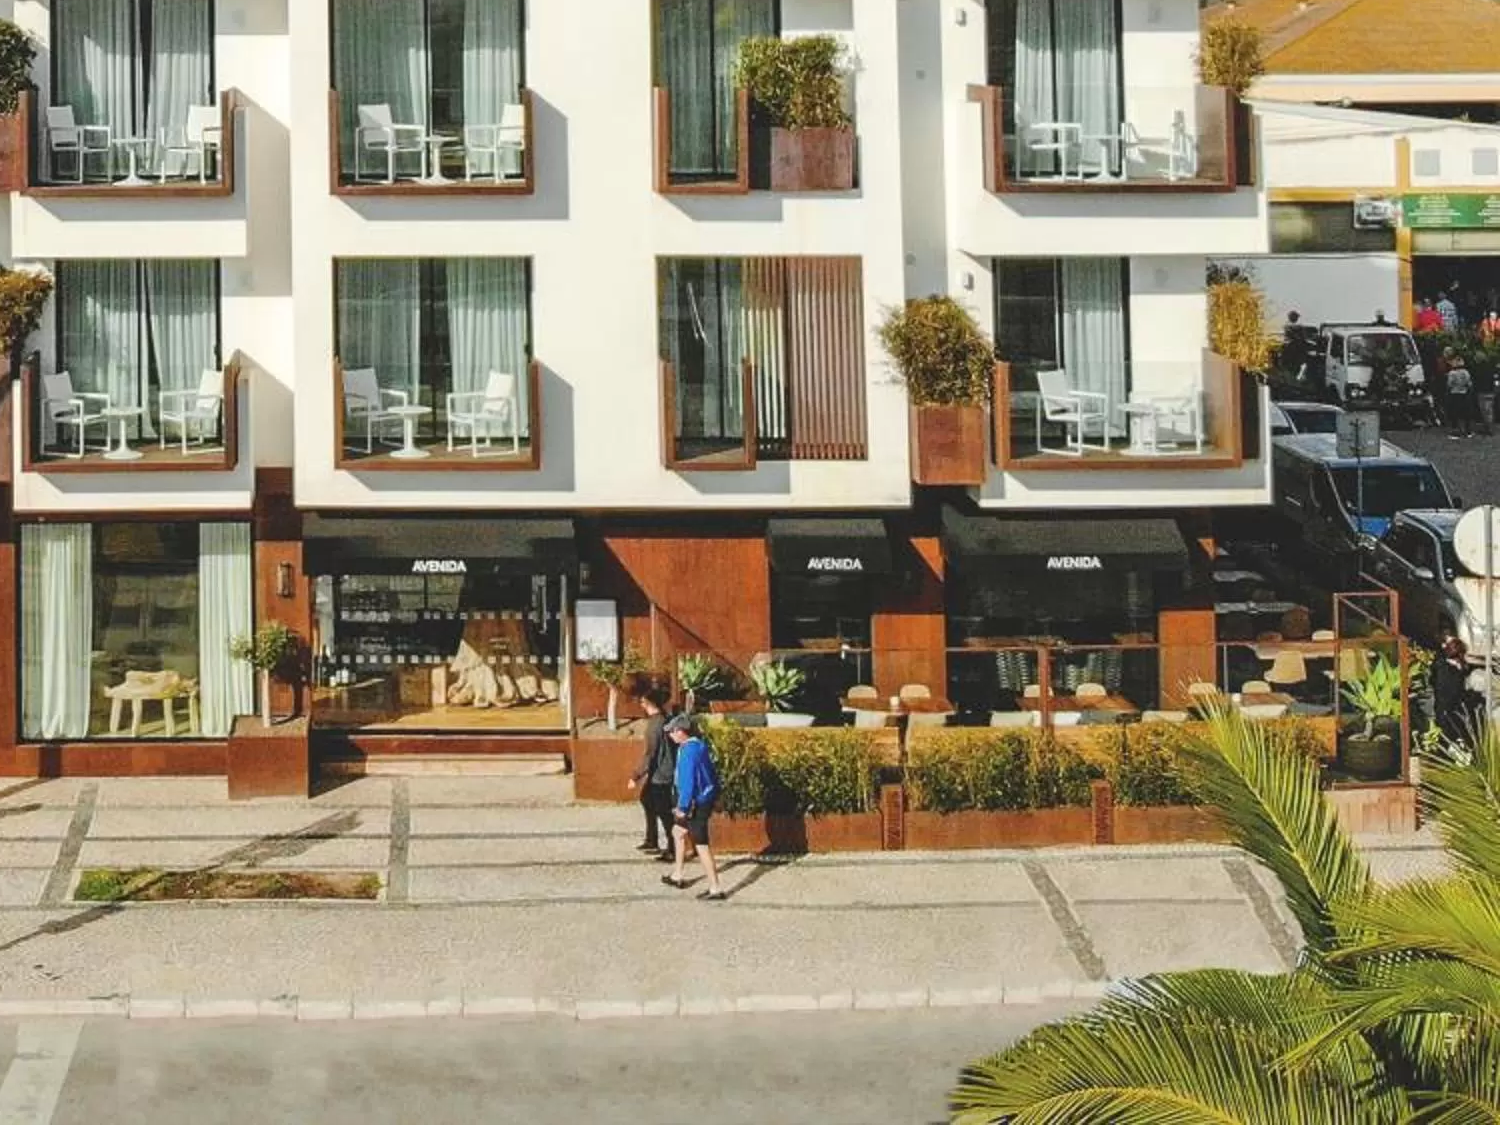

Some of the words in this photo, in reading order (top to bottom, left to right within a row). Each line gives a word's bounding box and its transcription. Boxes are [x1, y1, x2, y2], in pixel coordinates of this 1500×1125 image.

[412, 559, 467, 573] AVENIDA
[807, 557, 863, 571] AVENIDA
[1047, 556, 1102, 570] AVENIDA
